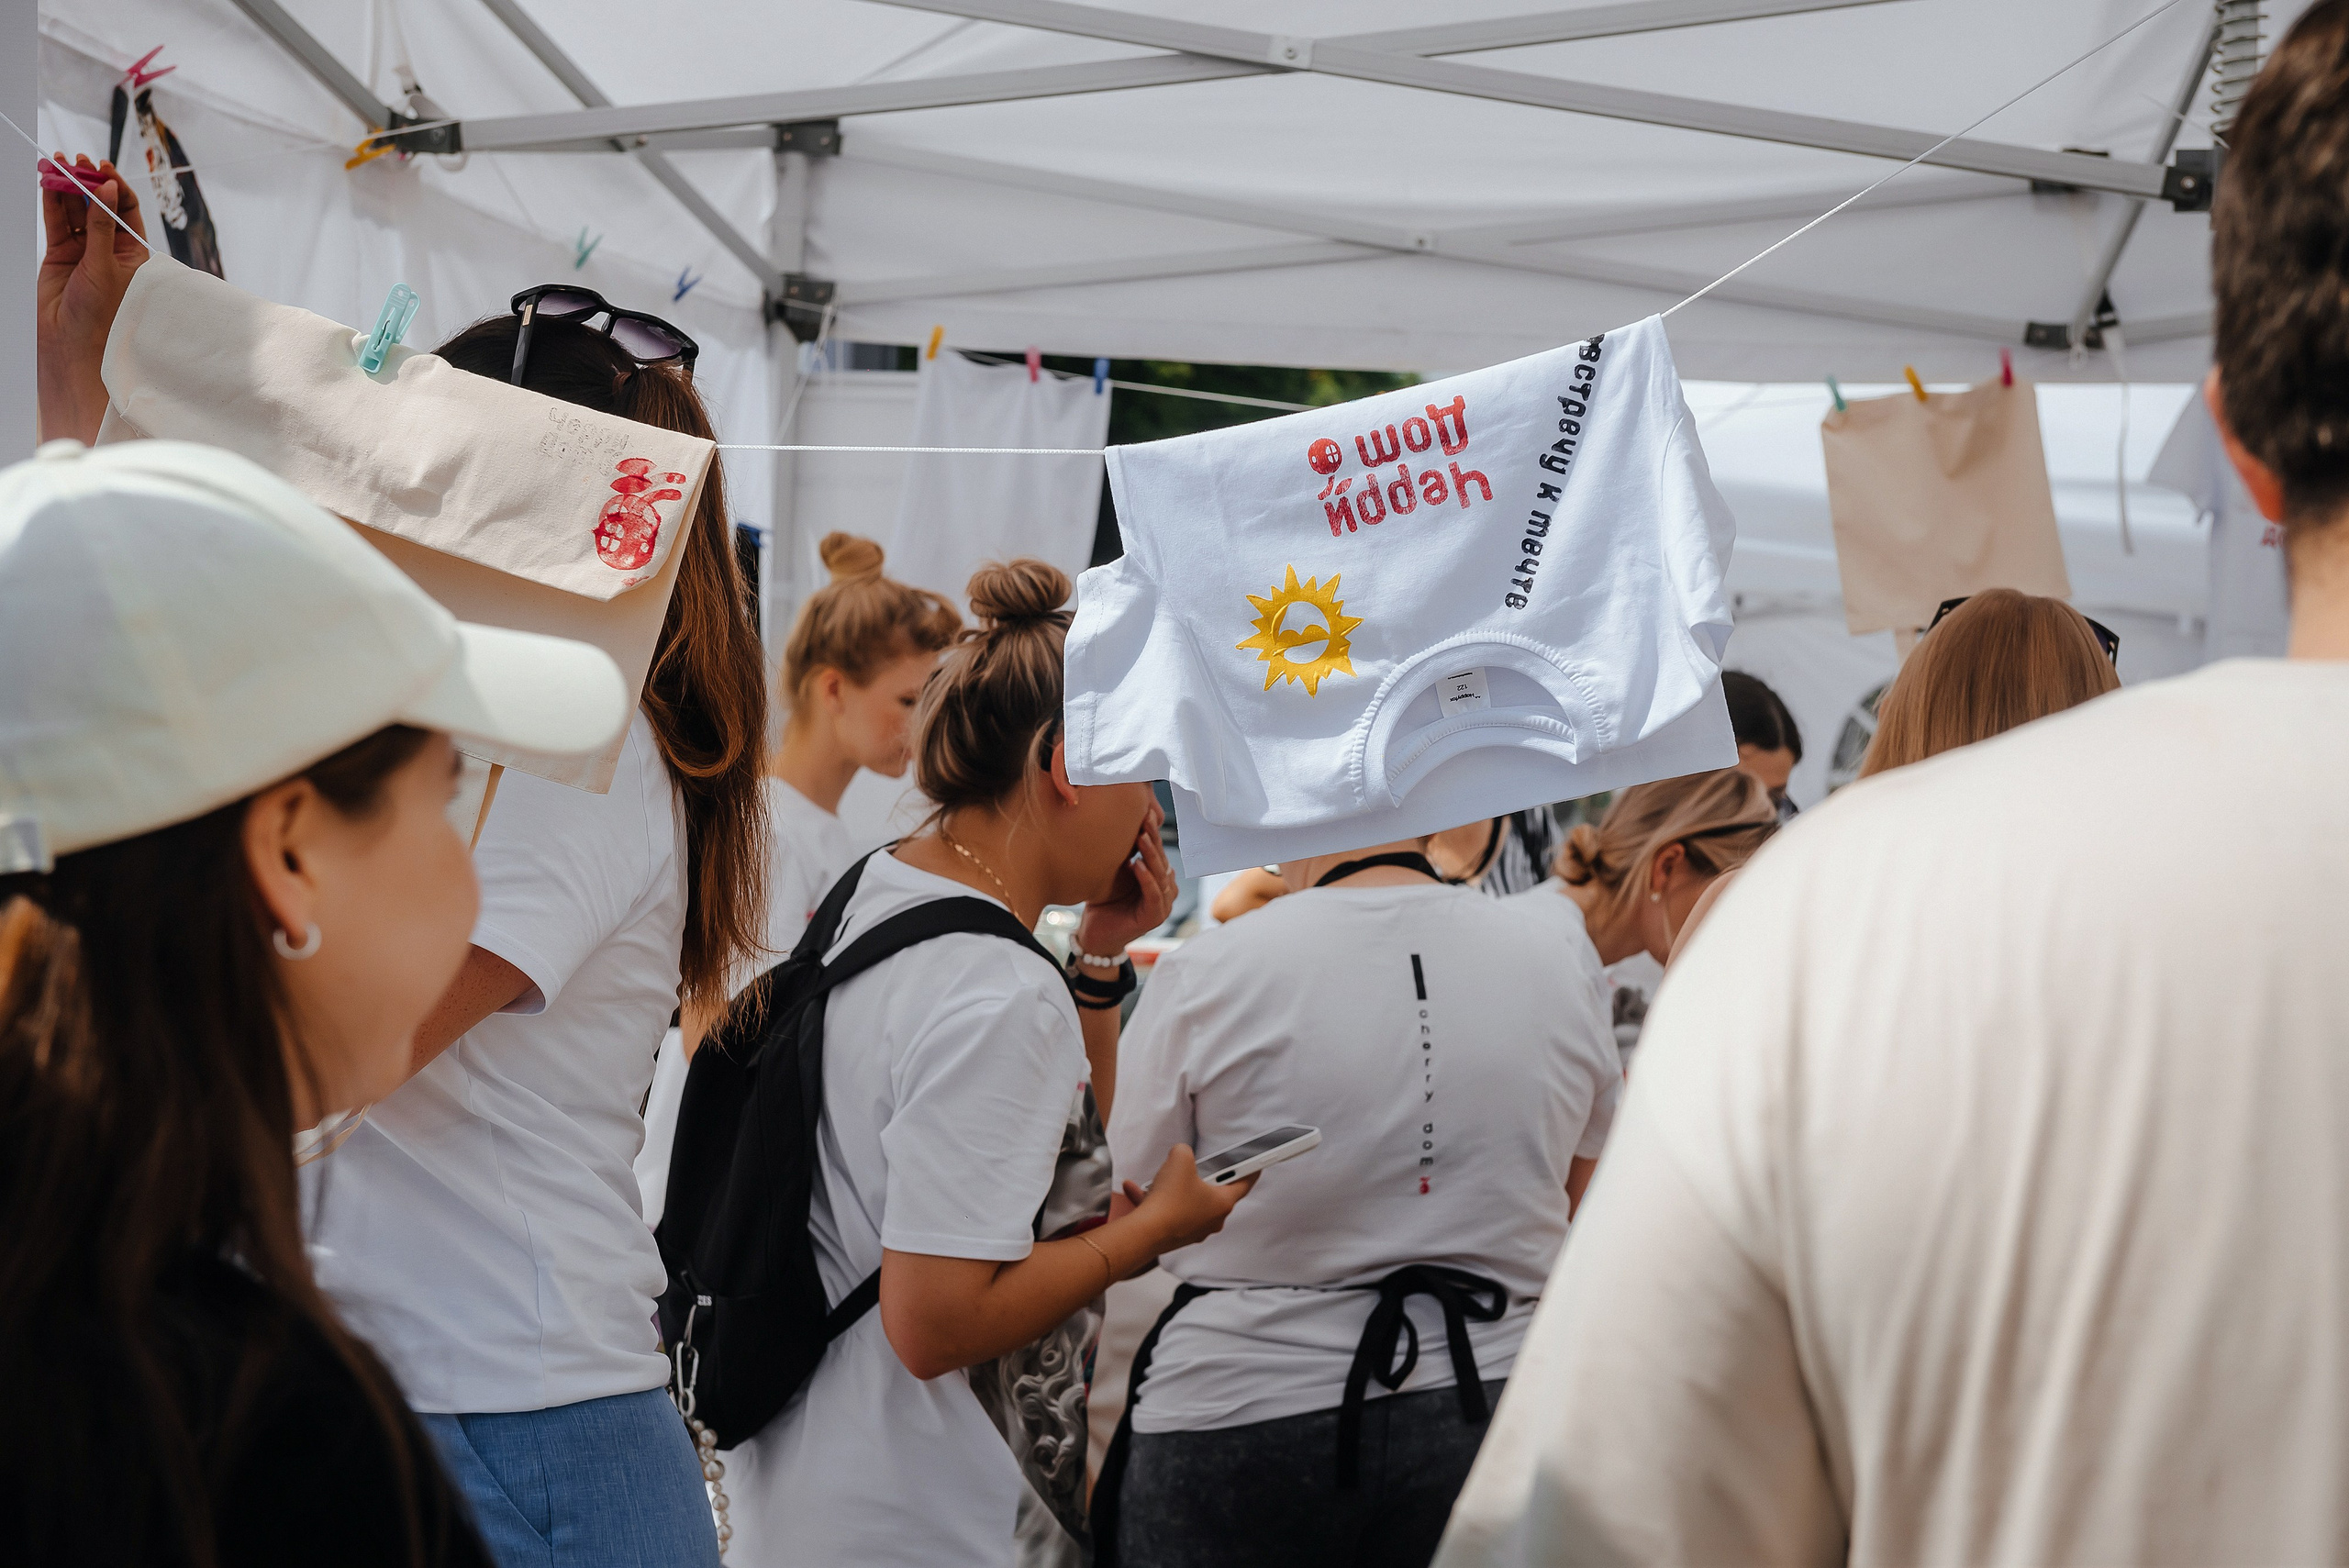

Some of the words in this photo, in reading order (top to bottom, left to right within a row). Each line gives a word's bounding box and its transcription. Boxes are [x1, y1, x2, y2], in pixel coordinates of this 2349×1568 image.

[1355, 395, 1468, 467] Дом
[1537, 482, 1563, 503] к
[1505, 510, 1552, 609] мечте
[1419, 1009, 1434, 1103] cherry
[1419, 1121, 1434, 1167] dom
